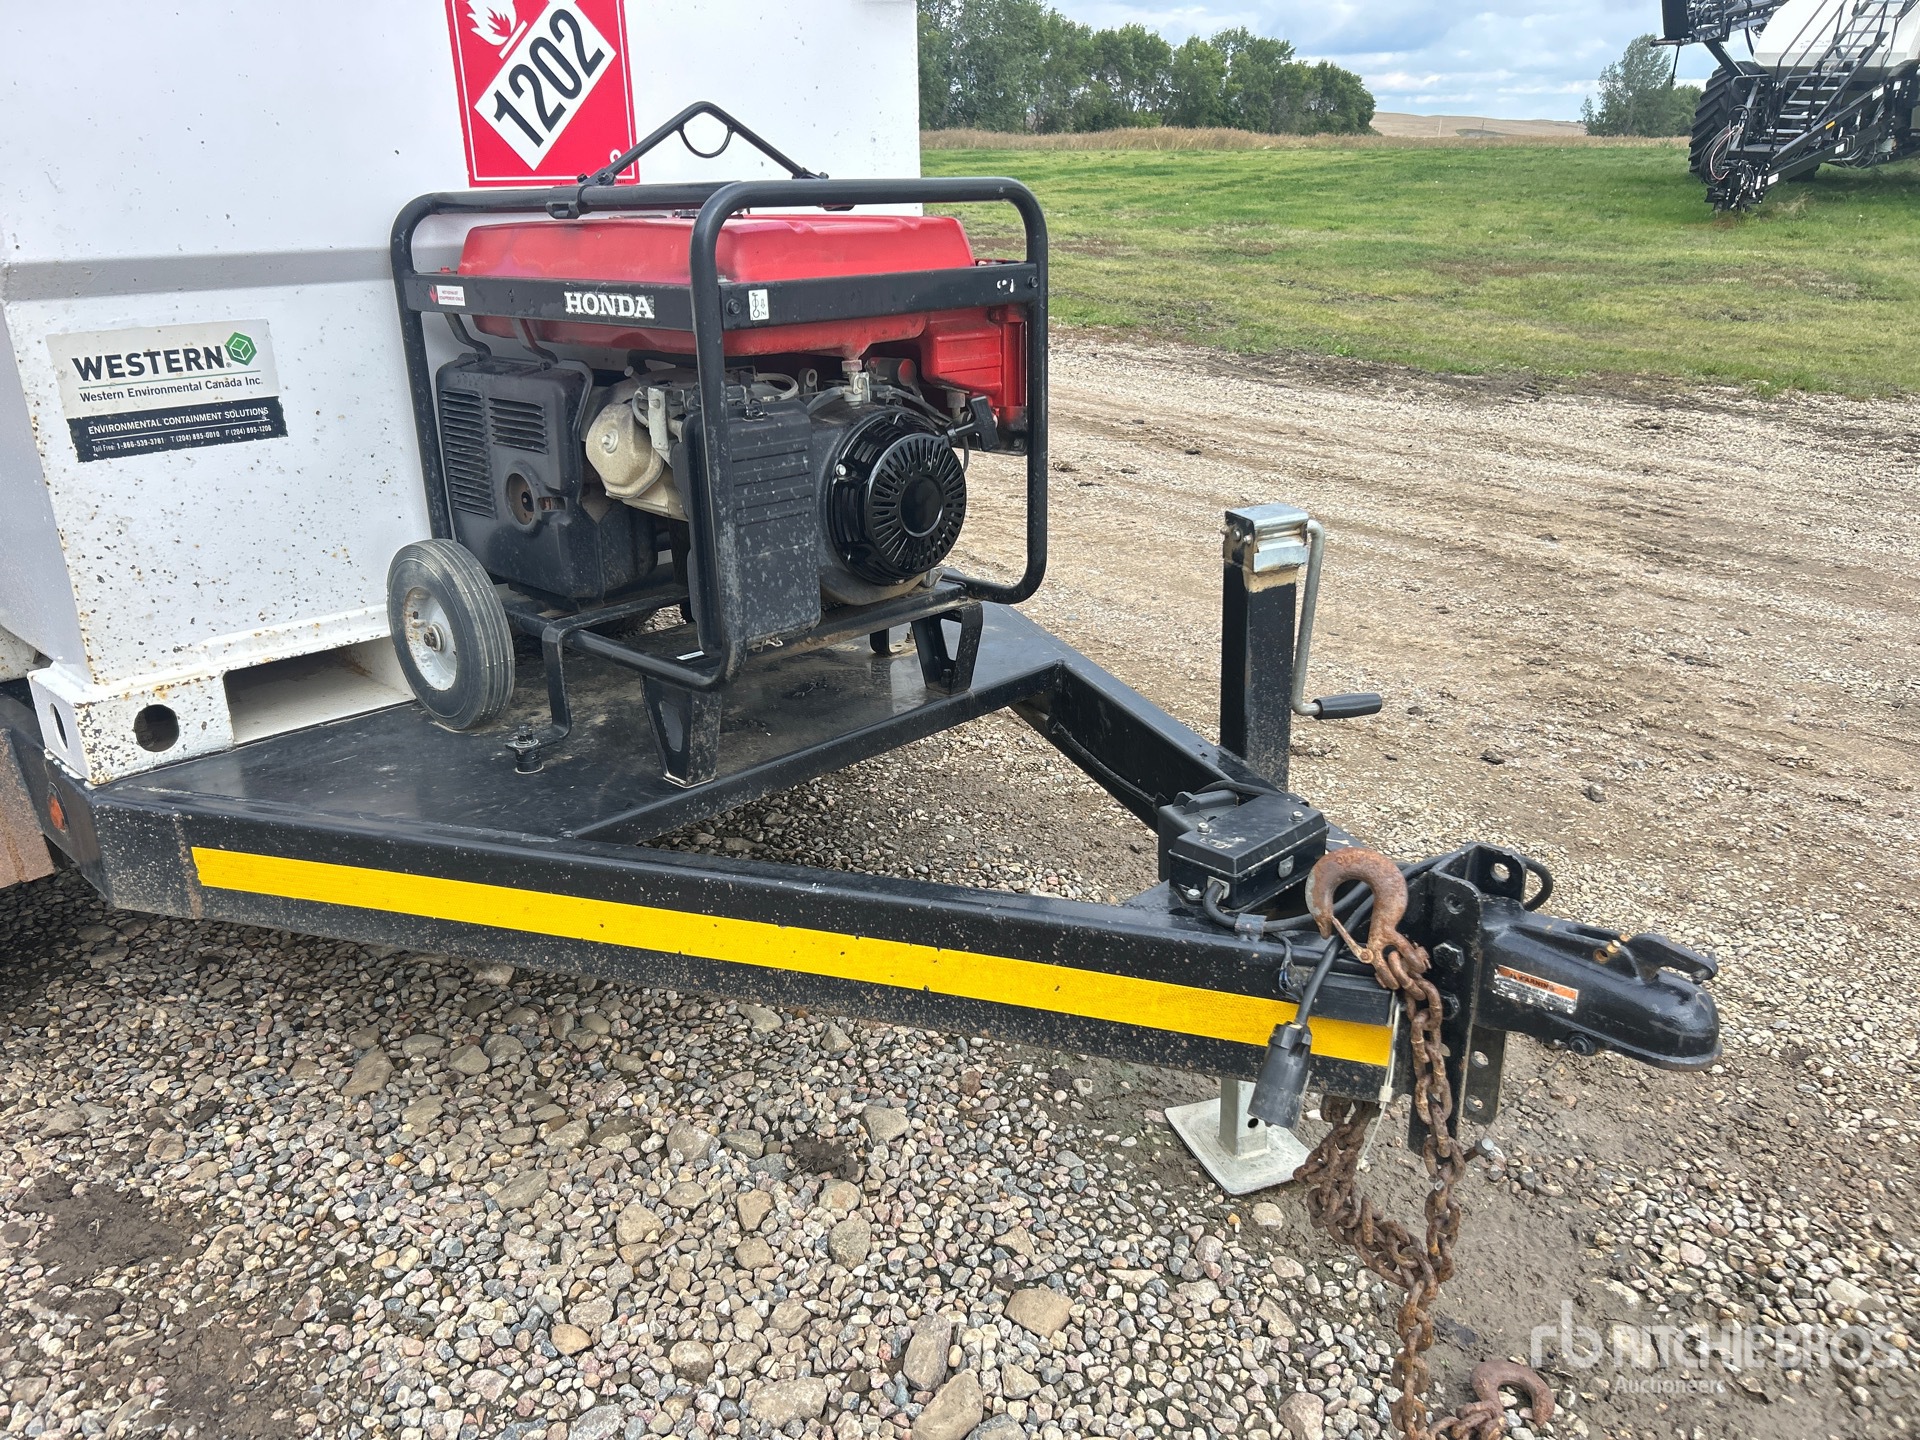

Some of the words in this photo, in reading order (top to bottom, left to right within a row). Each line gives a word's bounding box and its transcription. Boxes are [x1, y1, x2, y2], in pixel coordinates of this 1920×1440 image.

[494, 9, 606, 148] 1202
[563, 291, 655, 319] HONDA
[79, 391, 124, 403] Western
[127, 380, 202, 398] Environmental
[205, 377, 243, 390] Canada
[245, 374, 264, 386] Inc.
[88, 419, 162, 435] ENVIRONMENTAL
[163, 412, 222, 426] CONTAINMENT
[224, 406, 269, 419] SOLUTIONS
